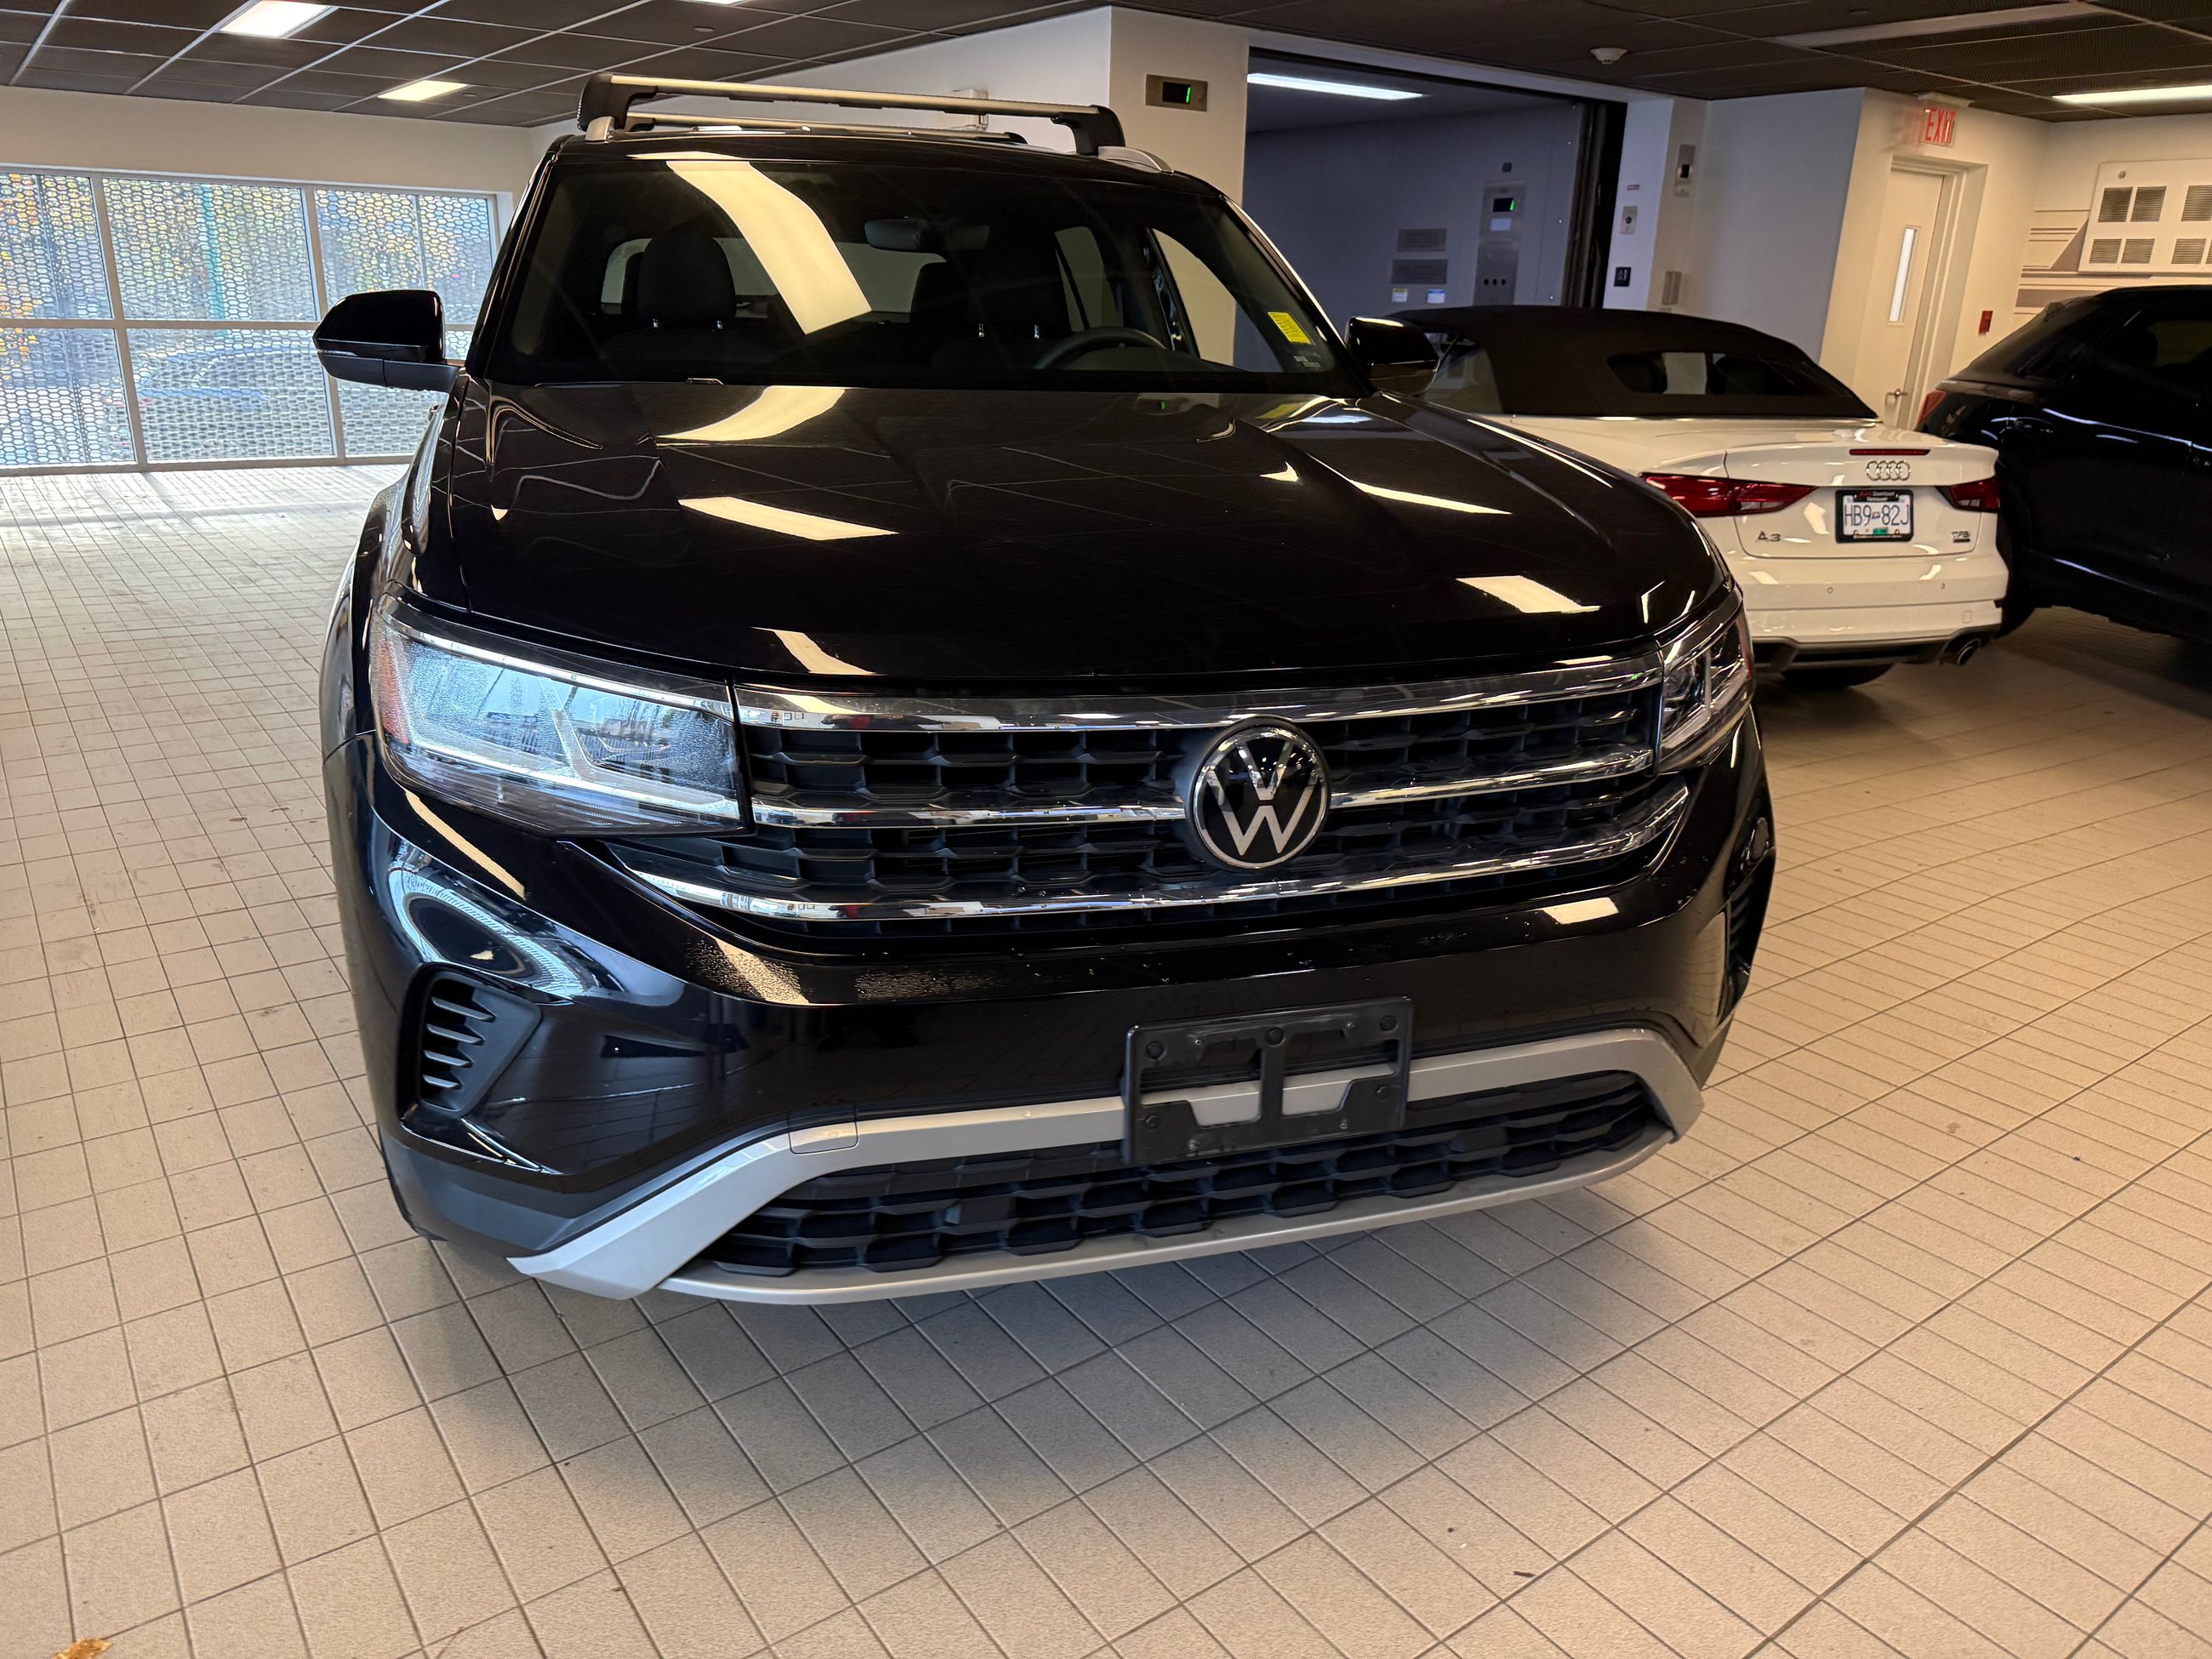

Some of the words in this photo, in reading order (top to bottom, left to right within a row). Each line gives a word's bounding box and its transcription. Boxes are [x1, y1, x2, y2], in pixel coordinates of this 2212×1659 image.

[1924, 108, 1957, 144] EXIT
[1844, 505, 1872, 526] HB9
[1881, 505, 1909, 526] 82J
[1755, 530, 1782, 543] A3
